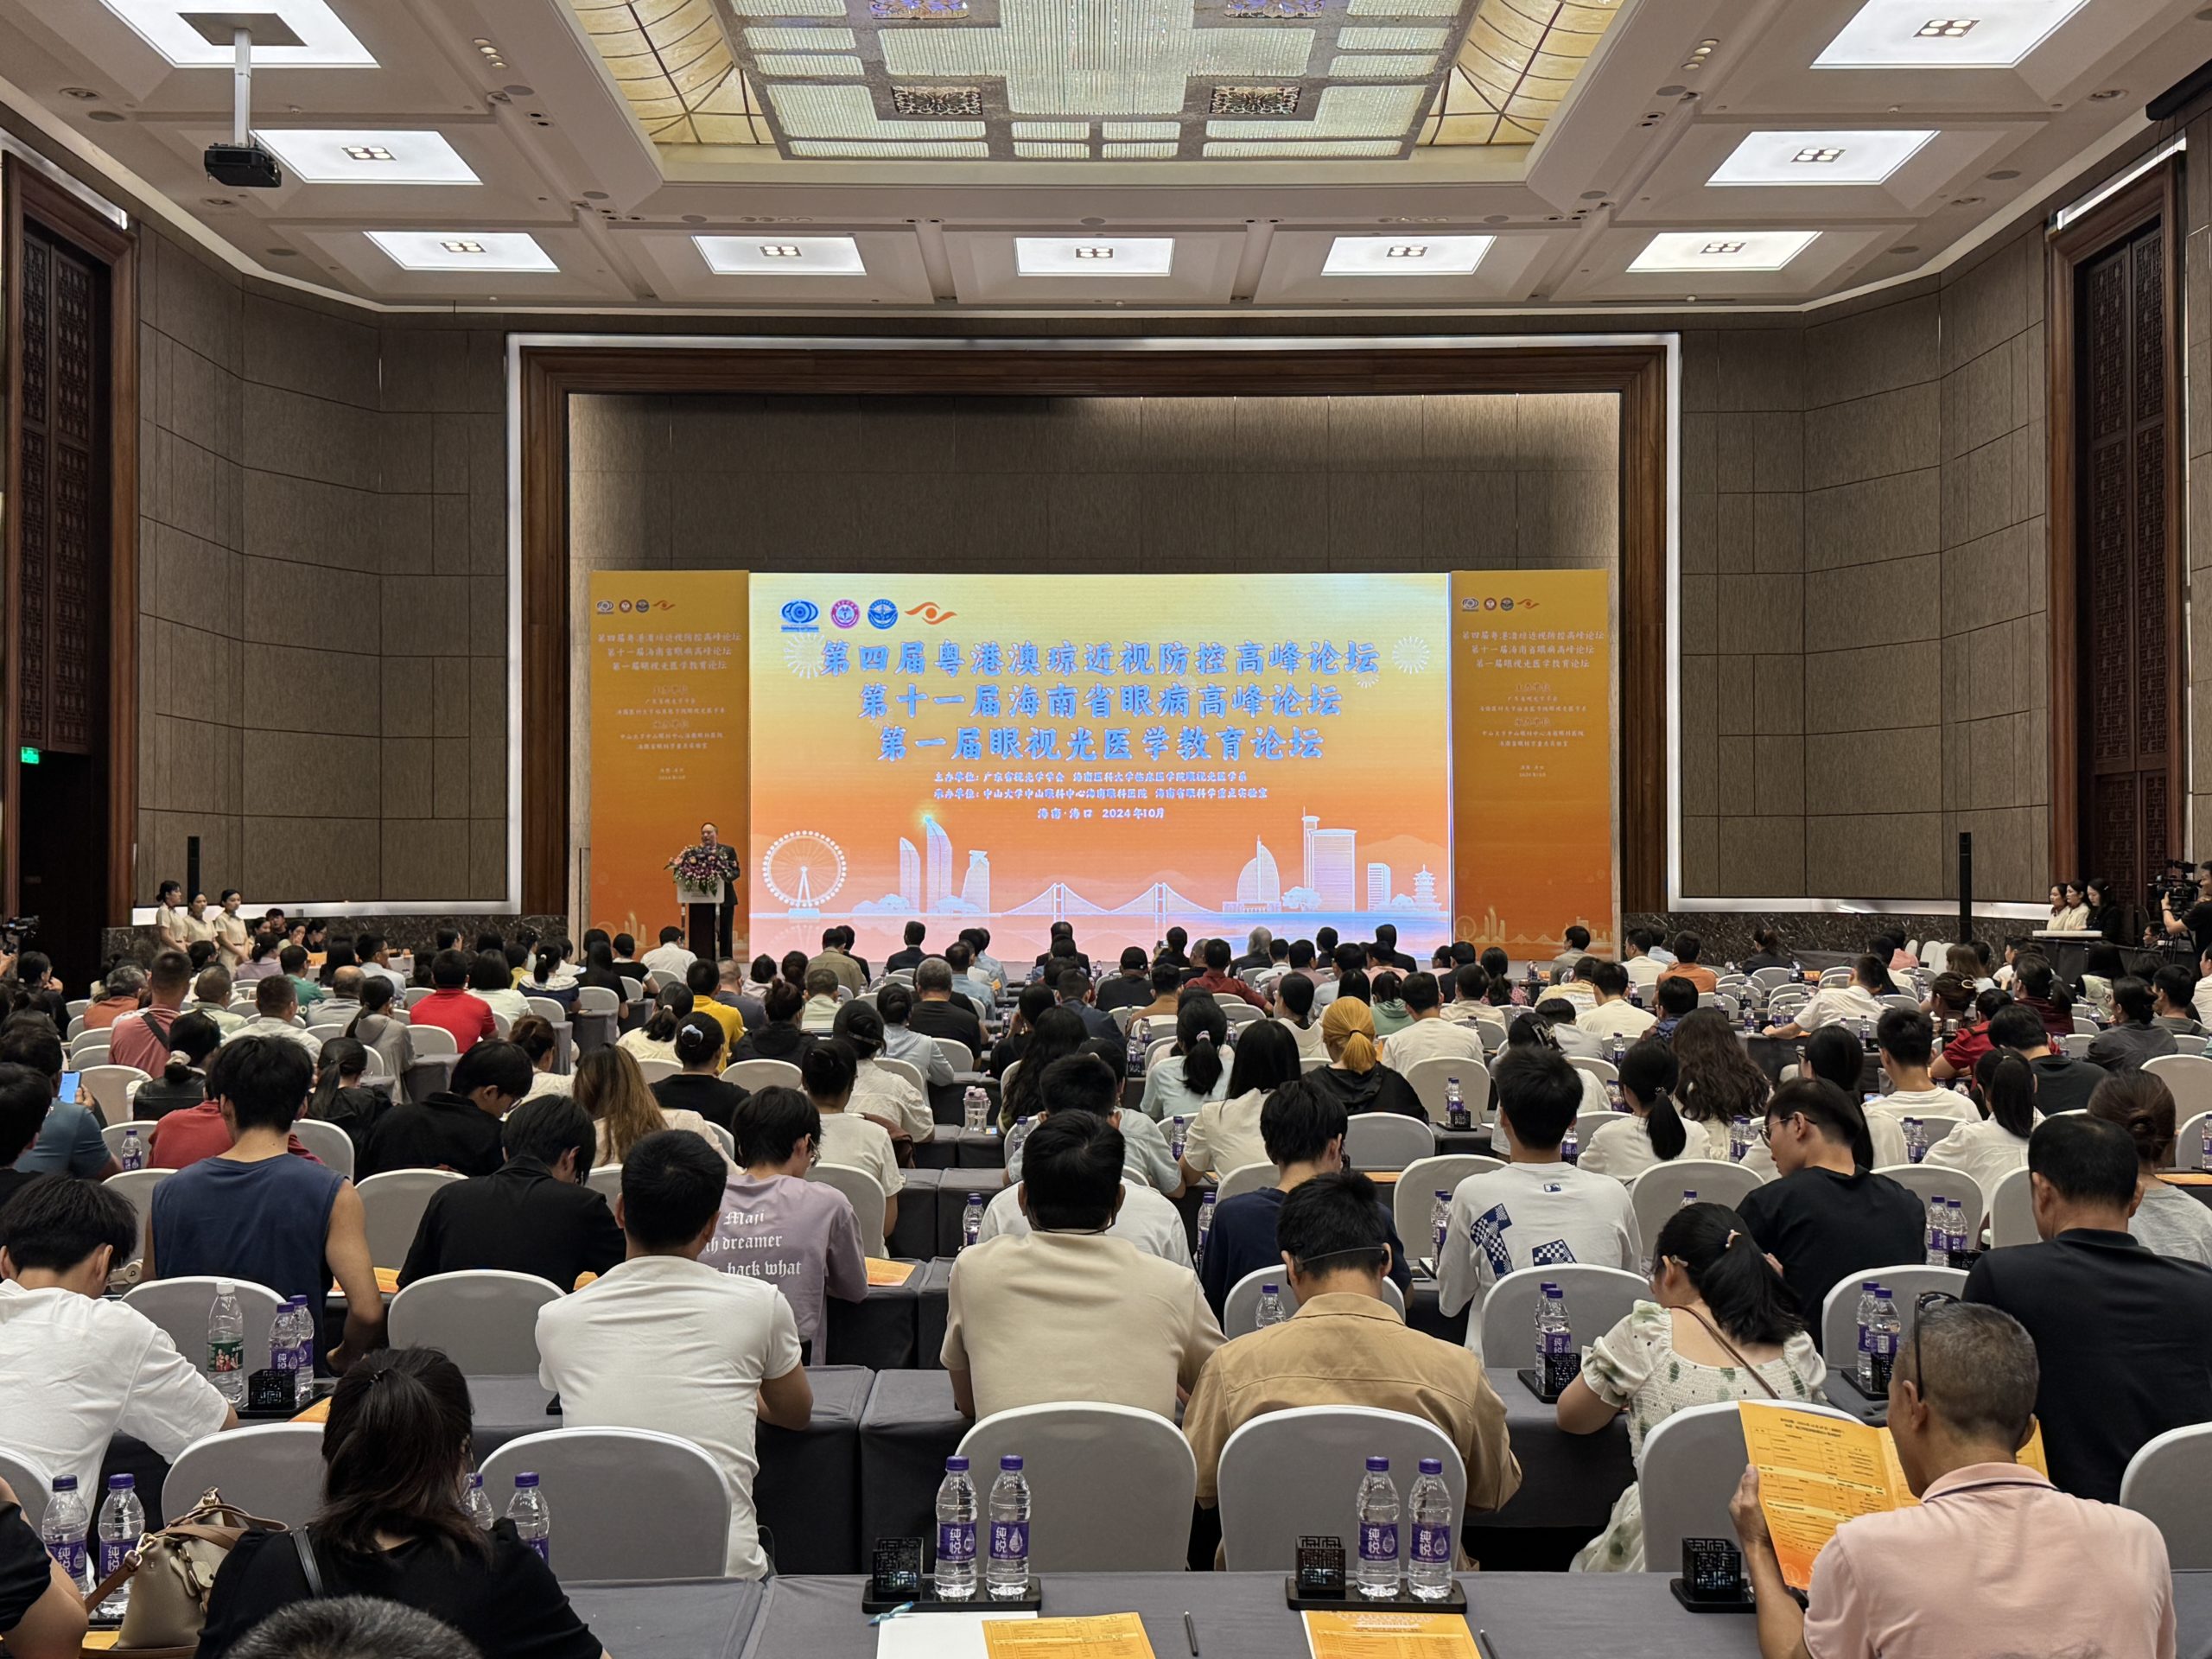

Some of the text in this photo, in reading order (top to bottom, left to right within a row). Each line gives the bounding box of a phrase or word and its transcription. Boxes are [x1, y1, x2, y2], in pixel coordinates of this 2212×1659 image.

[821, 639, 1380, 677] 第四届粤港澳琼近视防控高峰论坛
[858, 682, 1342, 720] 第十一届海南省眼病高峰论坛
[877, 725, 1324, 761] 第一届眼视光医学教育论坛
[722, 1235, 783, 1250] dreamer
[765, 1259, 802, 1278] what
[949, 1527, 962, 1554] 纯悦
[995, 1526, 1007, 1554] 纯悦
[1368, 1527, 1381, 1554] 纯悦
[1419, 1529, 1432, 1557] 纯悦
